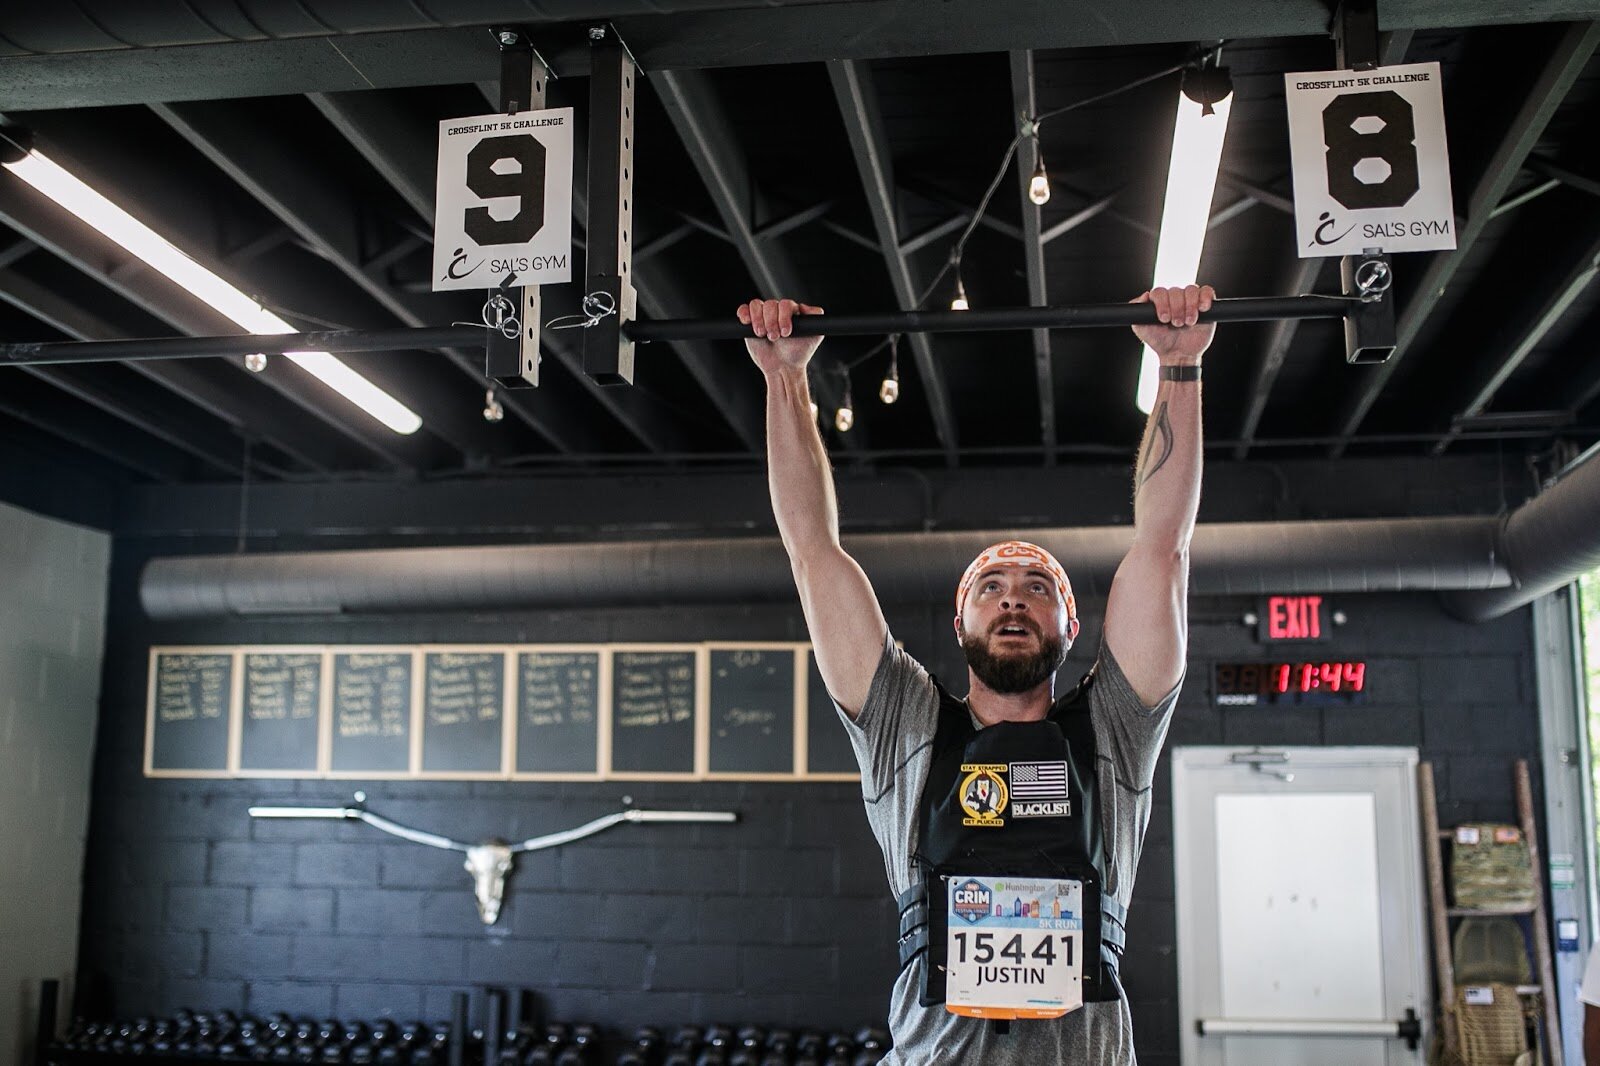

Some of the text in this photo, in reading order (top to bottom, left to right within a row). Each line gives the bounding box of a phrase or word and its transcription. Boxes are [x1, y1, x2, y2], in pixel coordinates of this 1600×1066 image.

[1296, 73, 1430, 90] CROSSFLINT 5K CHALLENGE
[448, 117, 564, 136] CROSSFLINT 5K CHALLENGE
[1322, 90, 1420, 210] 8
[464, 133, 547, 246] 9
[1363, 220, 1449, 239] SAL'S GYM
[490, 254, 566, 273] SAL'S GYM
[1268, 596, 1322, 639] EXIT
[1278, 662, 1366, 693] 11:44
[1012, 802, 1069, 816] BLACKLIST
[955, 890, 990, 904] CRIM
[1005, 882, 1046, 894] Huntington
[1039, 919, 1078, 929] 5K RUN
[954, 932, 1074, 966] 15441
[976, 966, 1045, 986] JUSTIN
